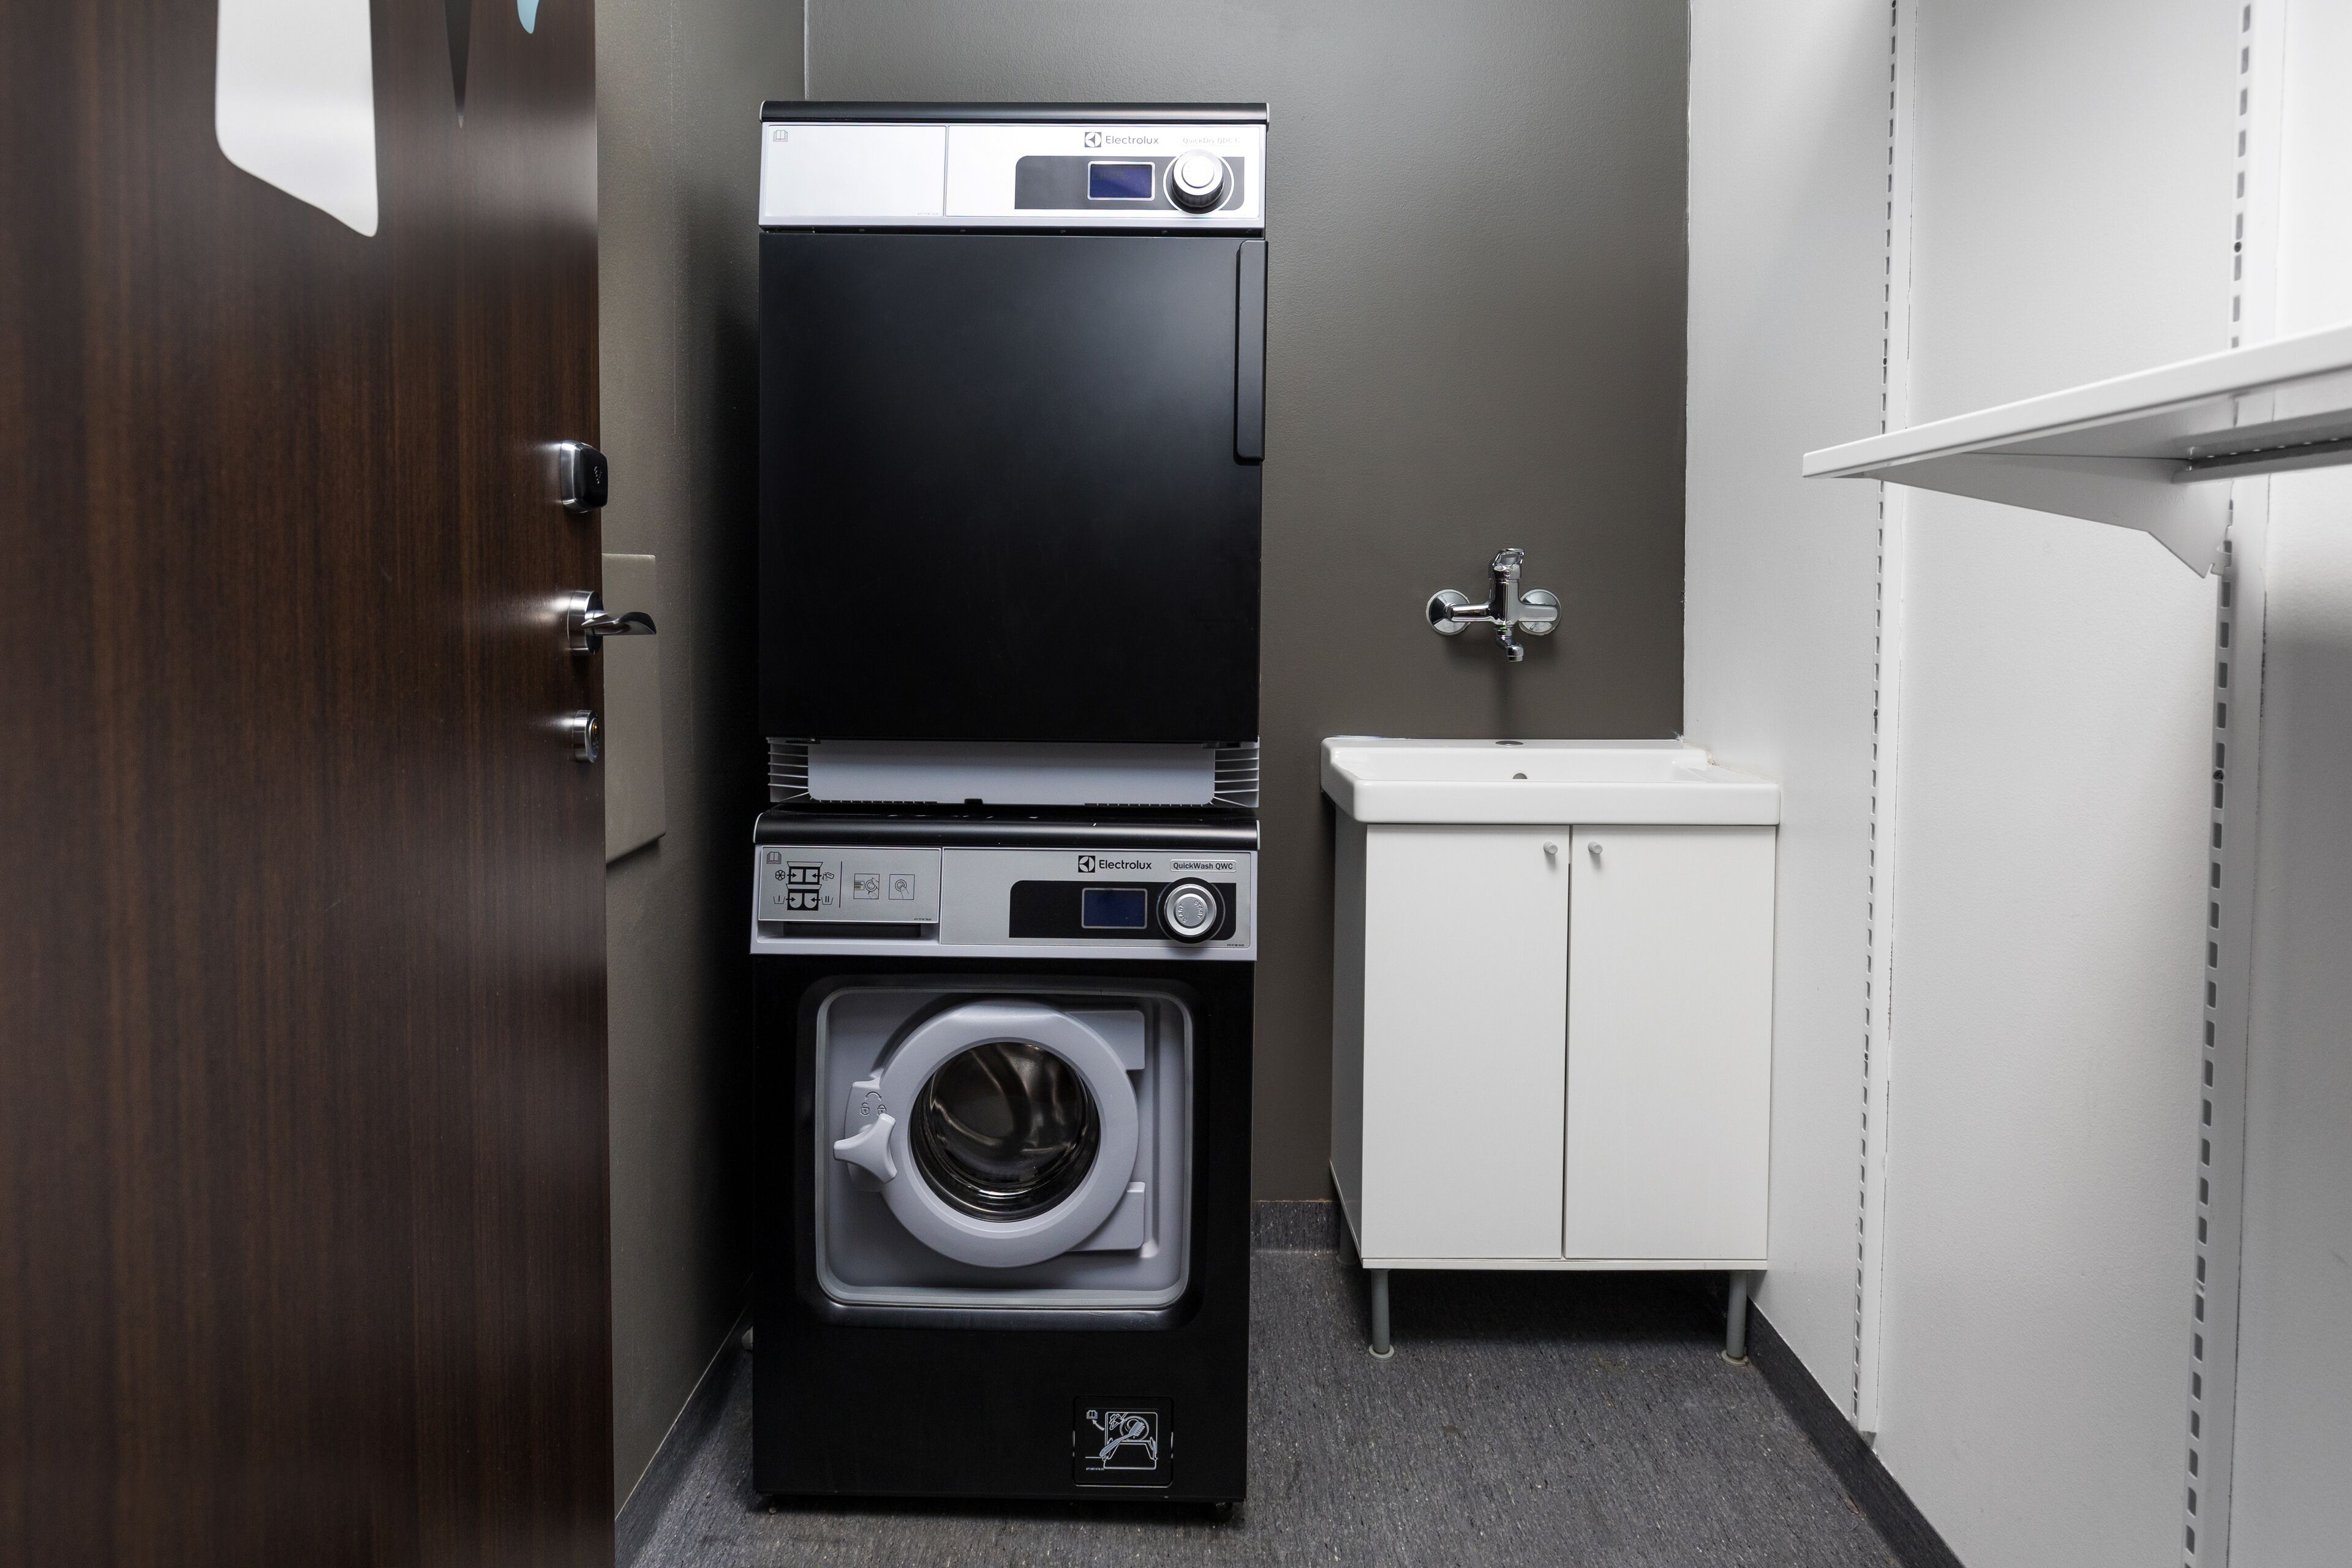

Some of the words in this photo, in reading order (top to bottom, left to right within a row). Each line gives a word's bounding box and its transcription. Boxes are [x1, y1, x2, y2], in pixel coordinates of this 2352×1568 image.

[1106, 135, 1159, 145] Electrolux
[1099, 859, 1152, 870] Electrolux
[1194, 900, 1203, 919] START
